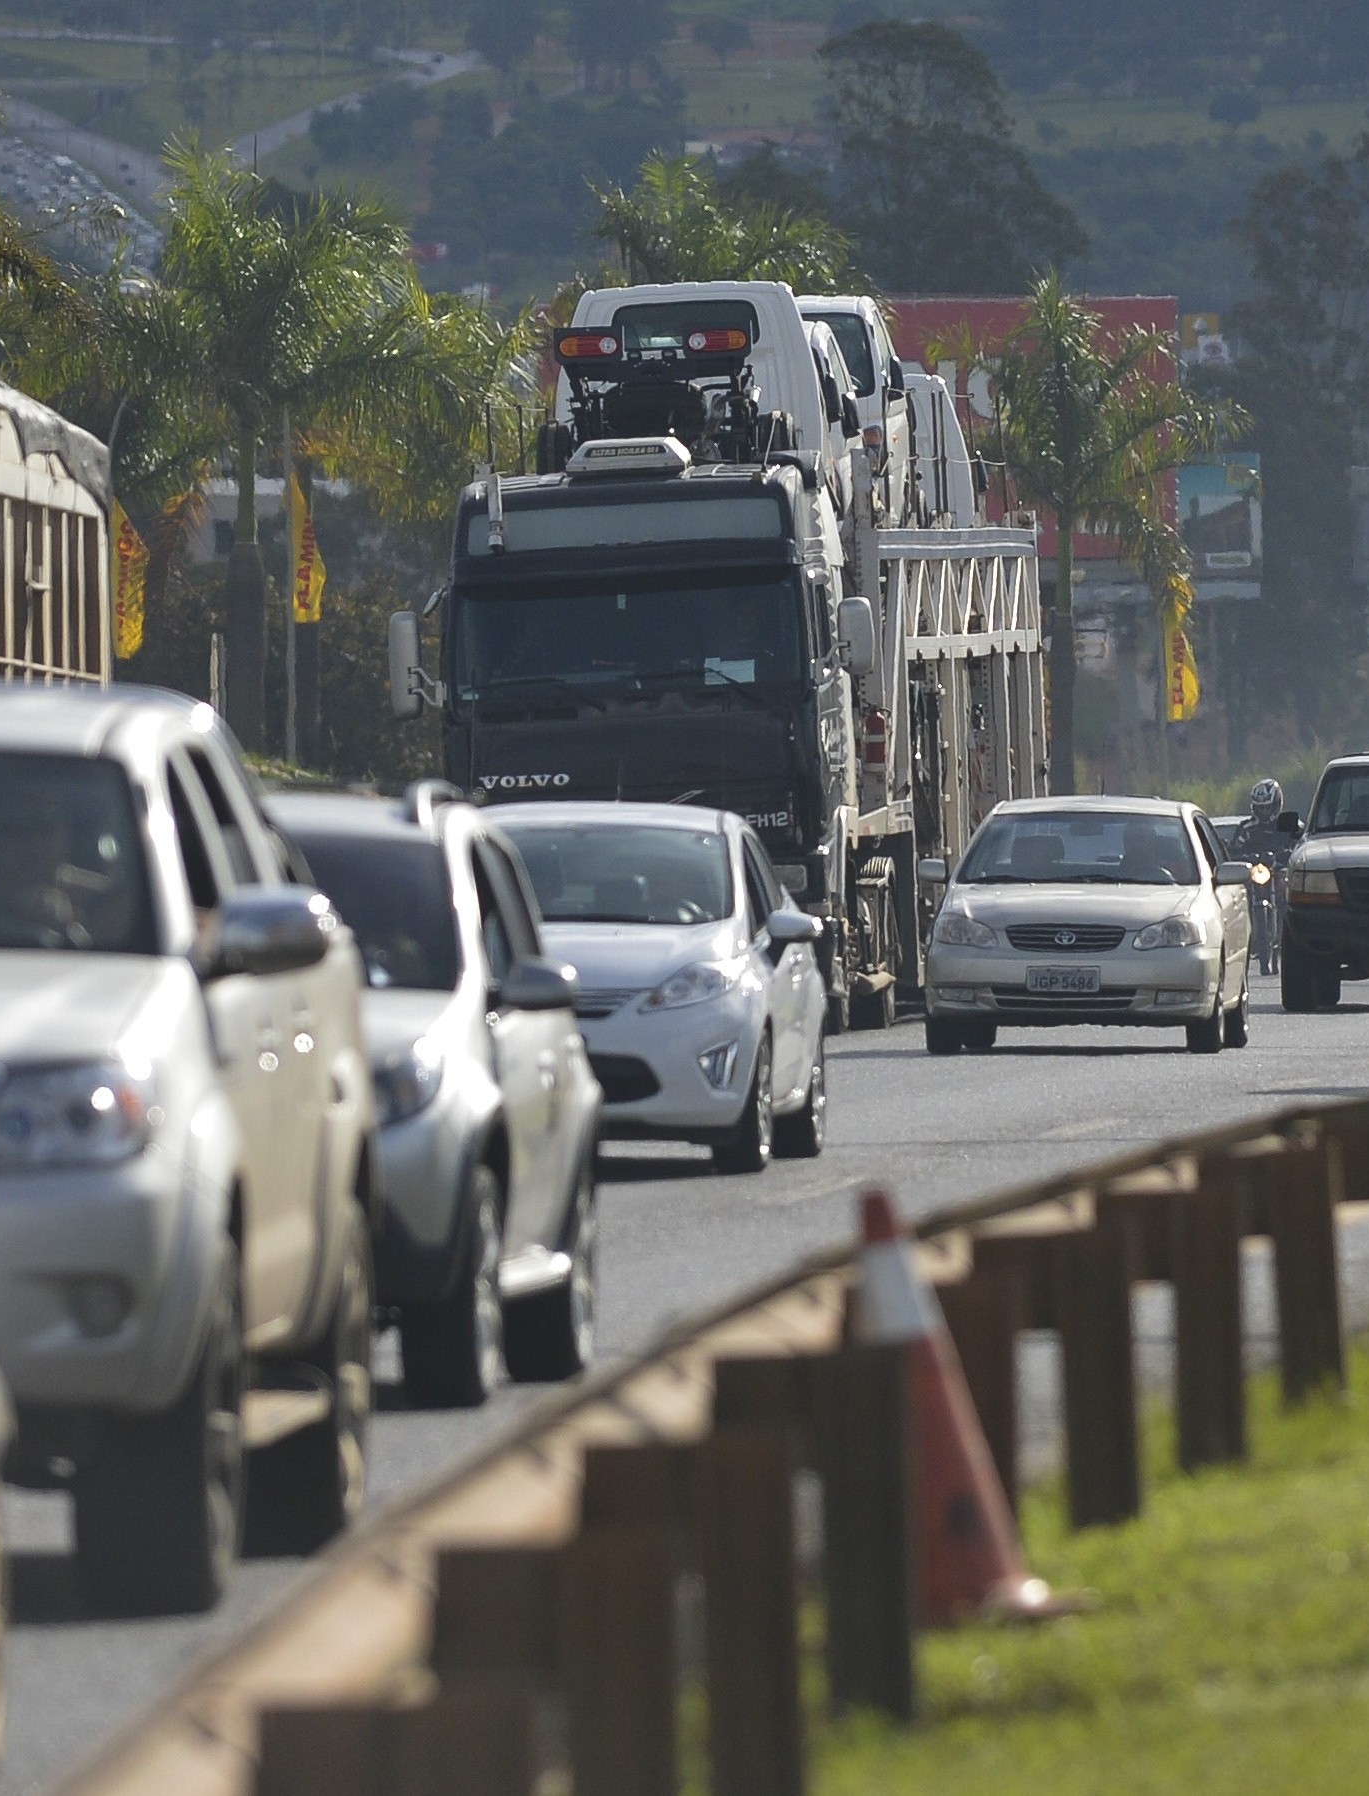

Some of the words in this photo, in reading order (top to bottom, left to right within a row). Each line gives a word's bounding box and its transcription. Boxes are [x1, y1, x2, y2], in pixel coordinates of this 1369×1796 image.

[478, 773, 570, 790] VOLVO
[745, 811, 789, 828] FH12
[1031, 976, 1059, 989] JGP
